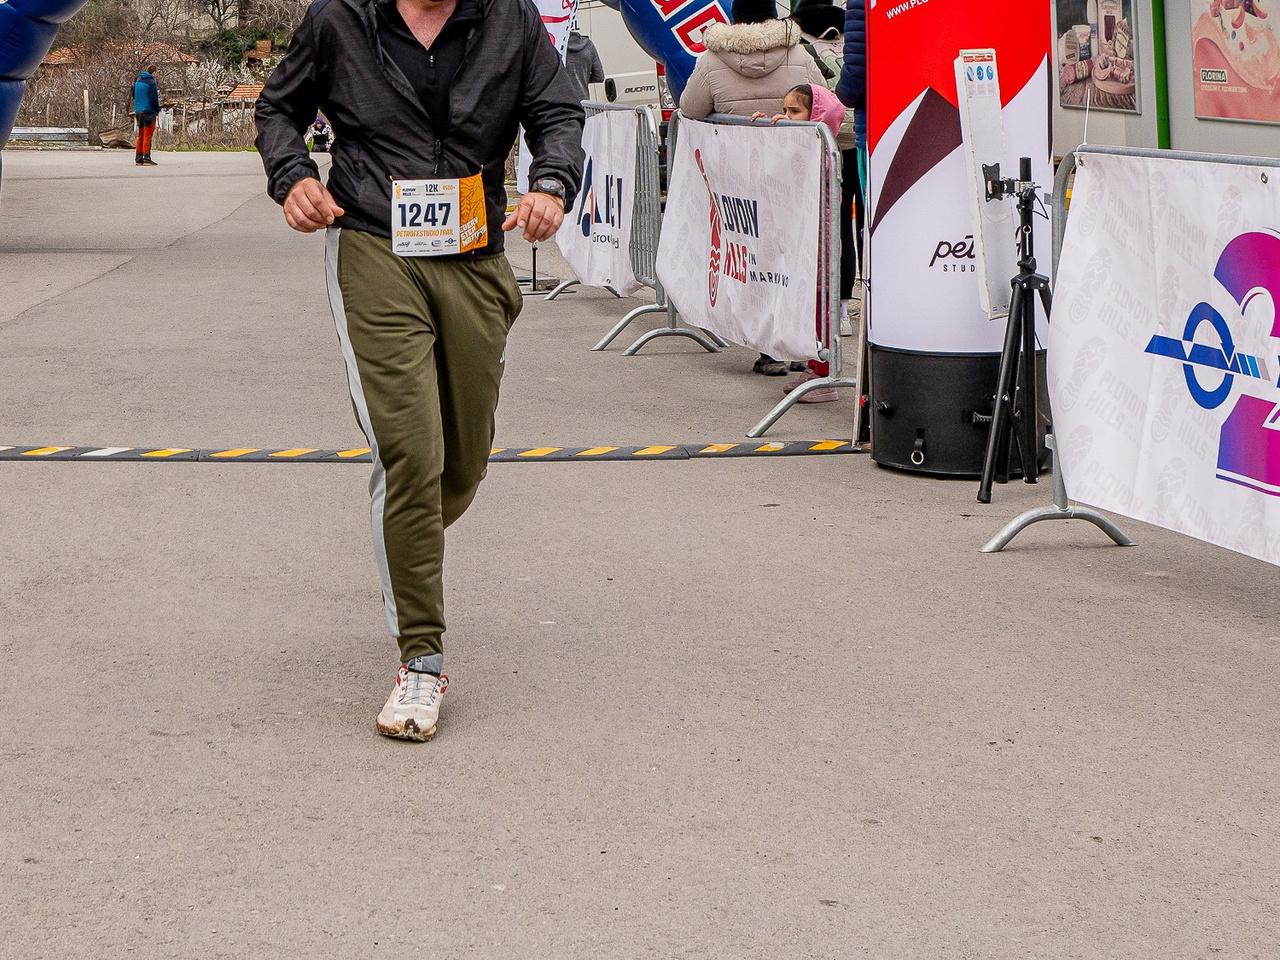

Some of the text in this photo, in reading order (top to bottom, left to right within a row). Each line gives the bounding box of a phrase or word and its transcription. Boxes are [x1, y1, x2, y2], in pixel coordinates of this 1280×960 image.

[1202, 70, 1227, 82] FLORINA
[625, 85, 656, 94] DUCATO
[425, 184, 439, 192] 12K
[398, 203, 451, 227] 1247
[749, 252, 757, 266] IN
[1184, 400, 1220, 441] PLOVD
